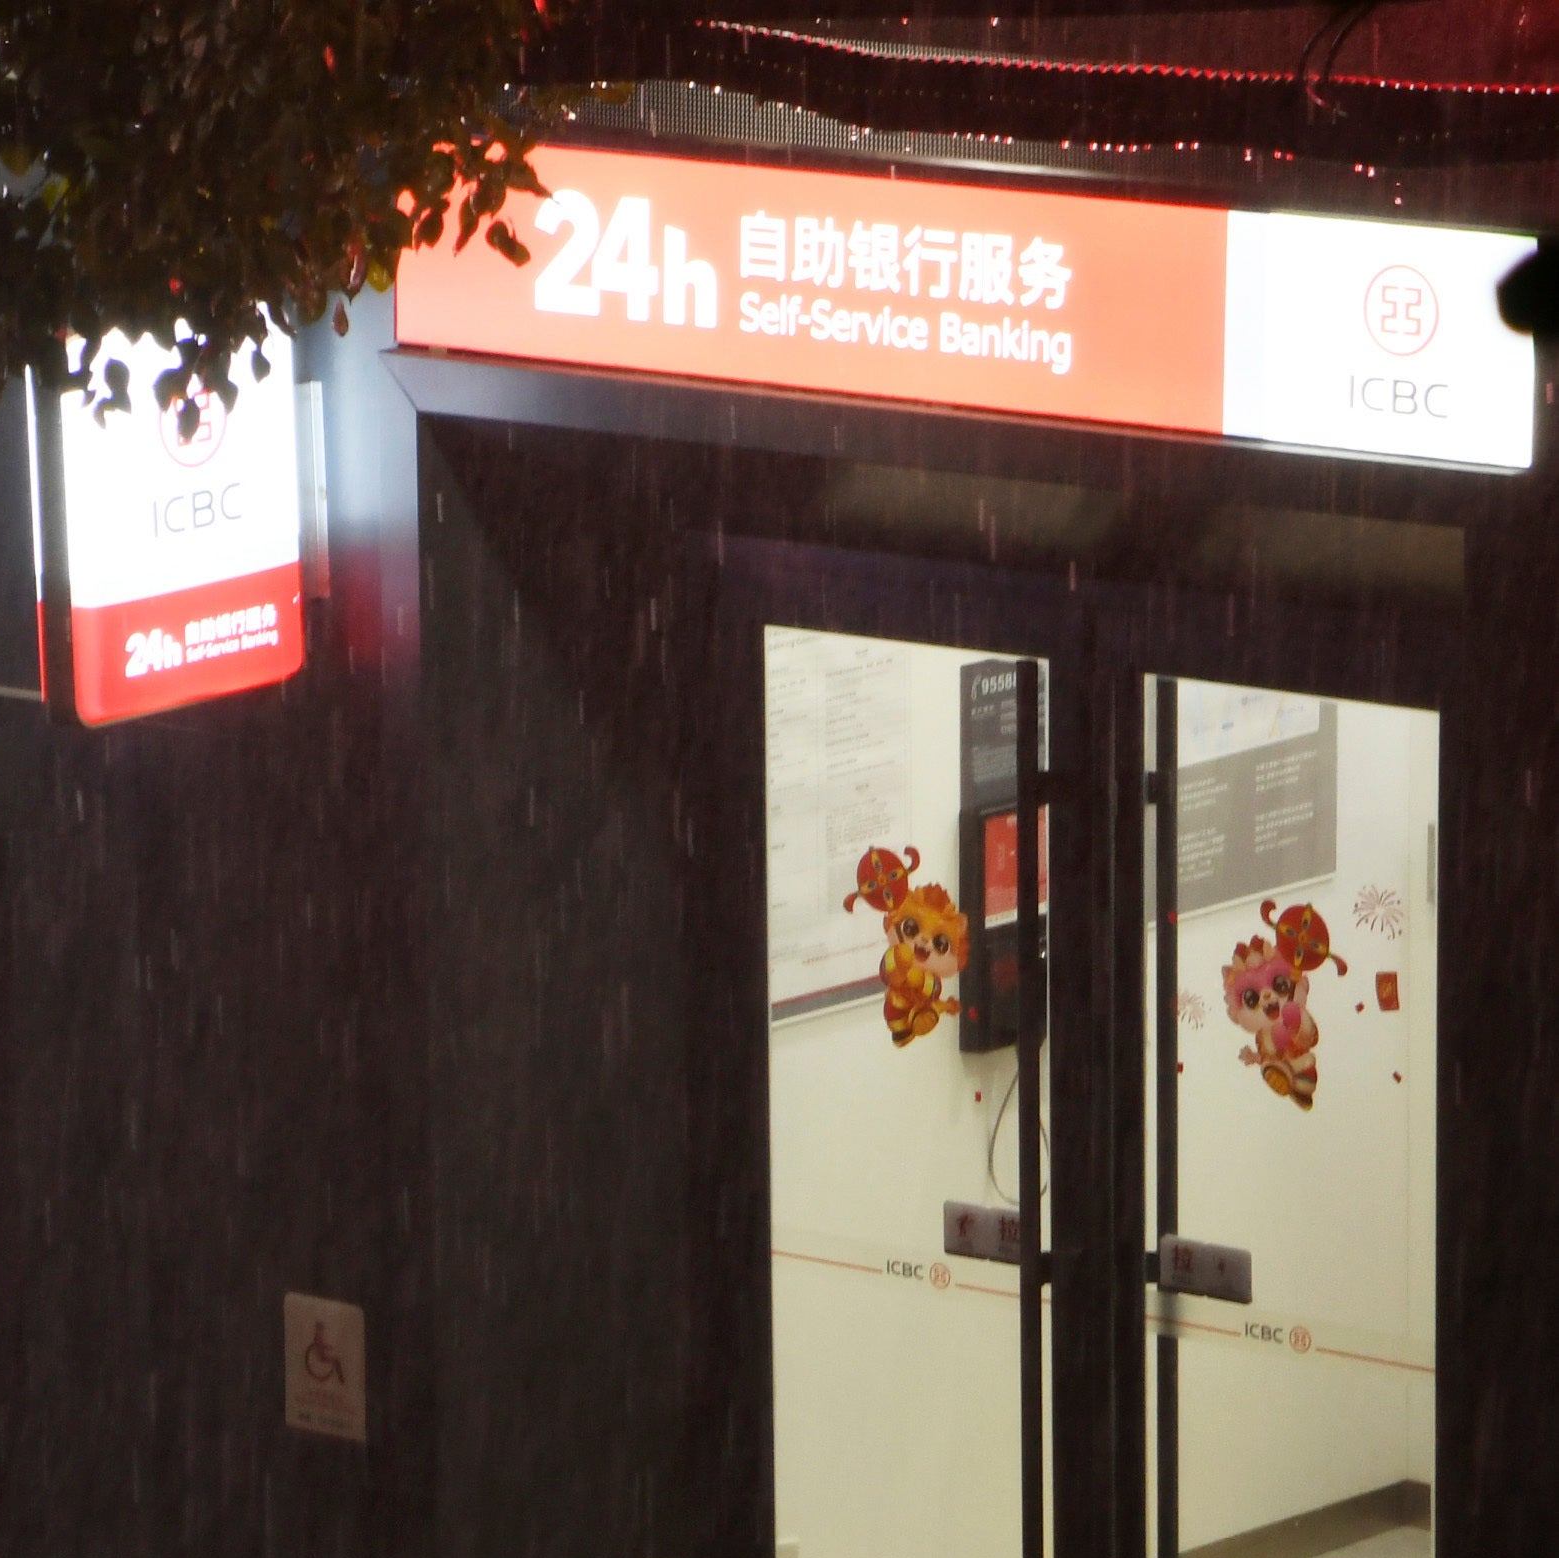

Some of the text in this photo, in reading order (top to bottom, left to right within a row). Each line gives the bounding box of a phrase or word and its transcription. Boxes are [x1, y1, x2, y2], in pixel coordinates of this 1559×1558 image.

[534, 189, 718, 329] 24h
[739, 210, 1073, 311] 自助银行服务
[739, 292, 1073, 376] Self-Service Banking
[1349, 374, 1449, 419] ICBC
[152, 482, 242, 538] ICBC
[125, 628, 183, 678] 24h
[186, 638, 240, 664] Self-Service
[886, 1259, 924, 1281] ICBC
[1244, 1322, 1284, 1344] ICBC
